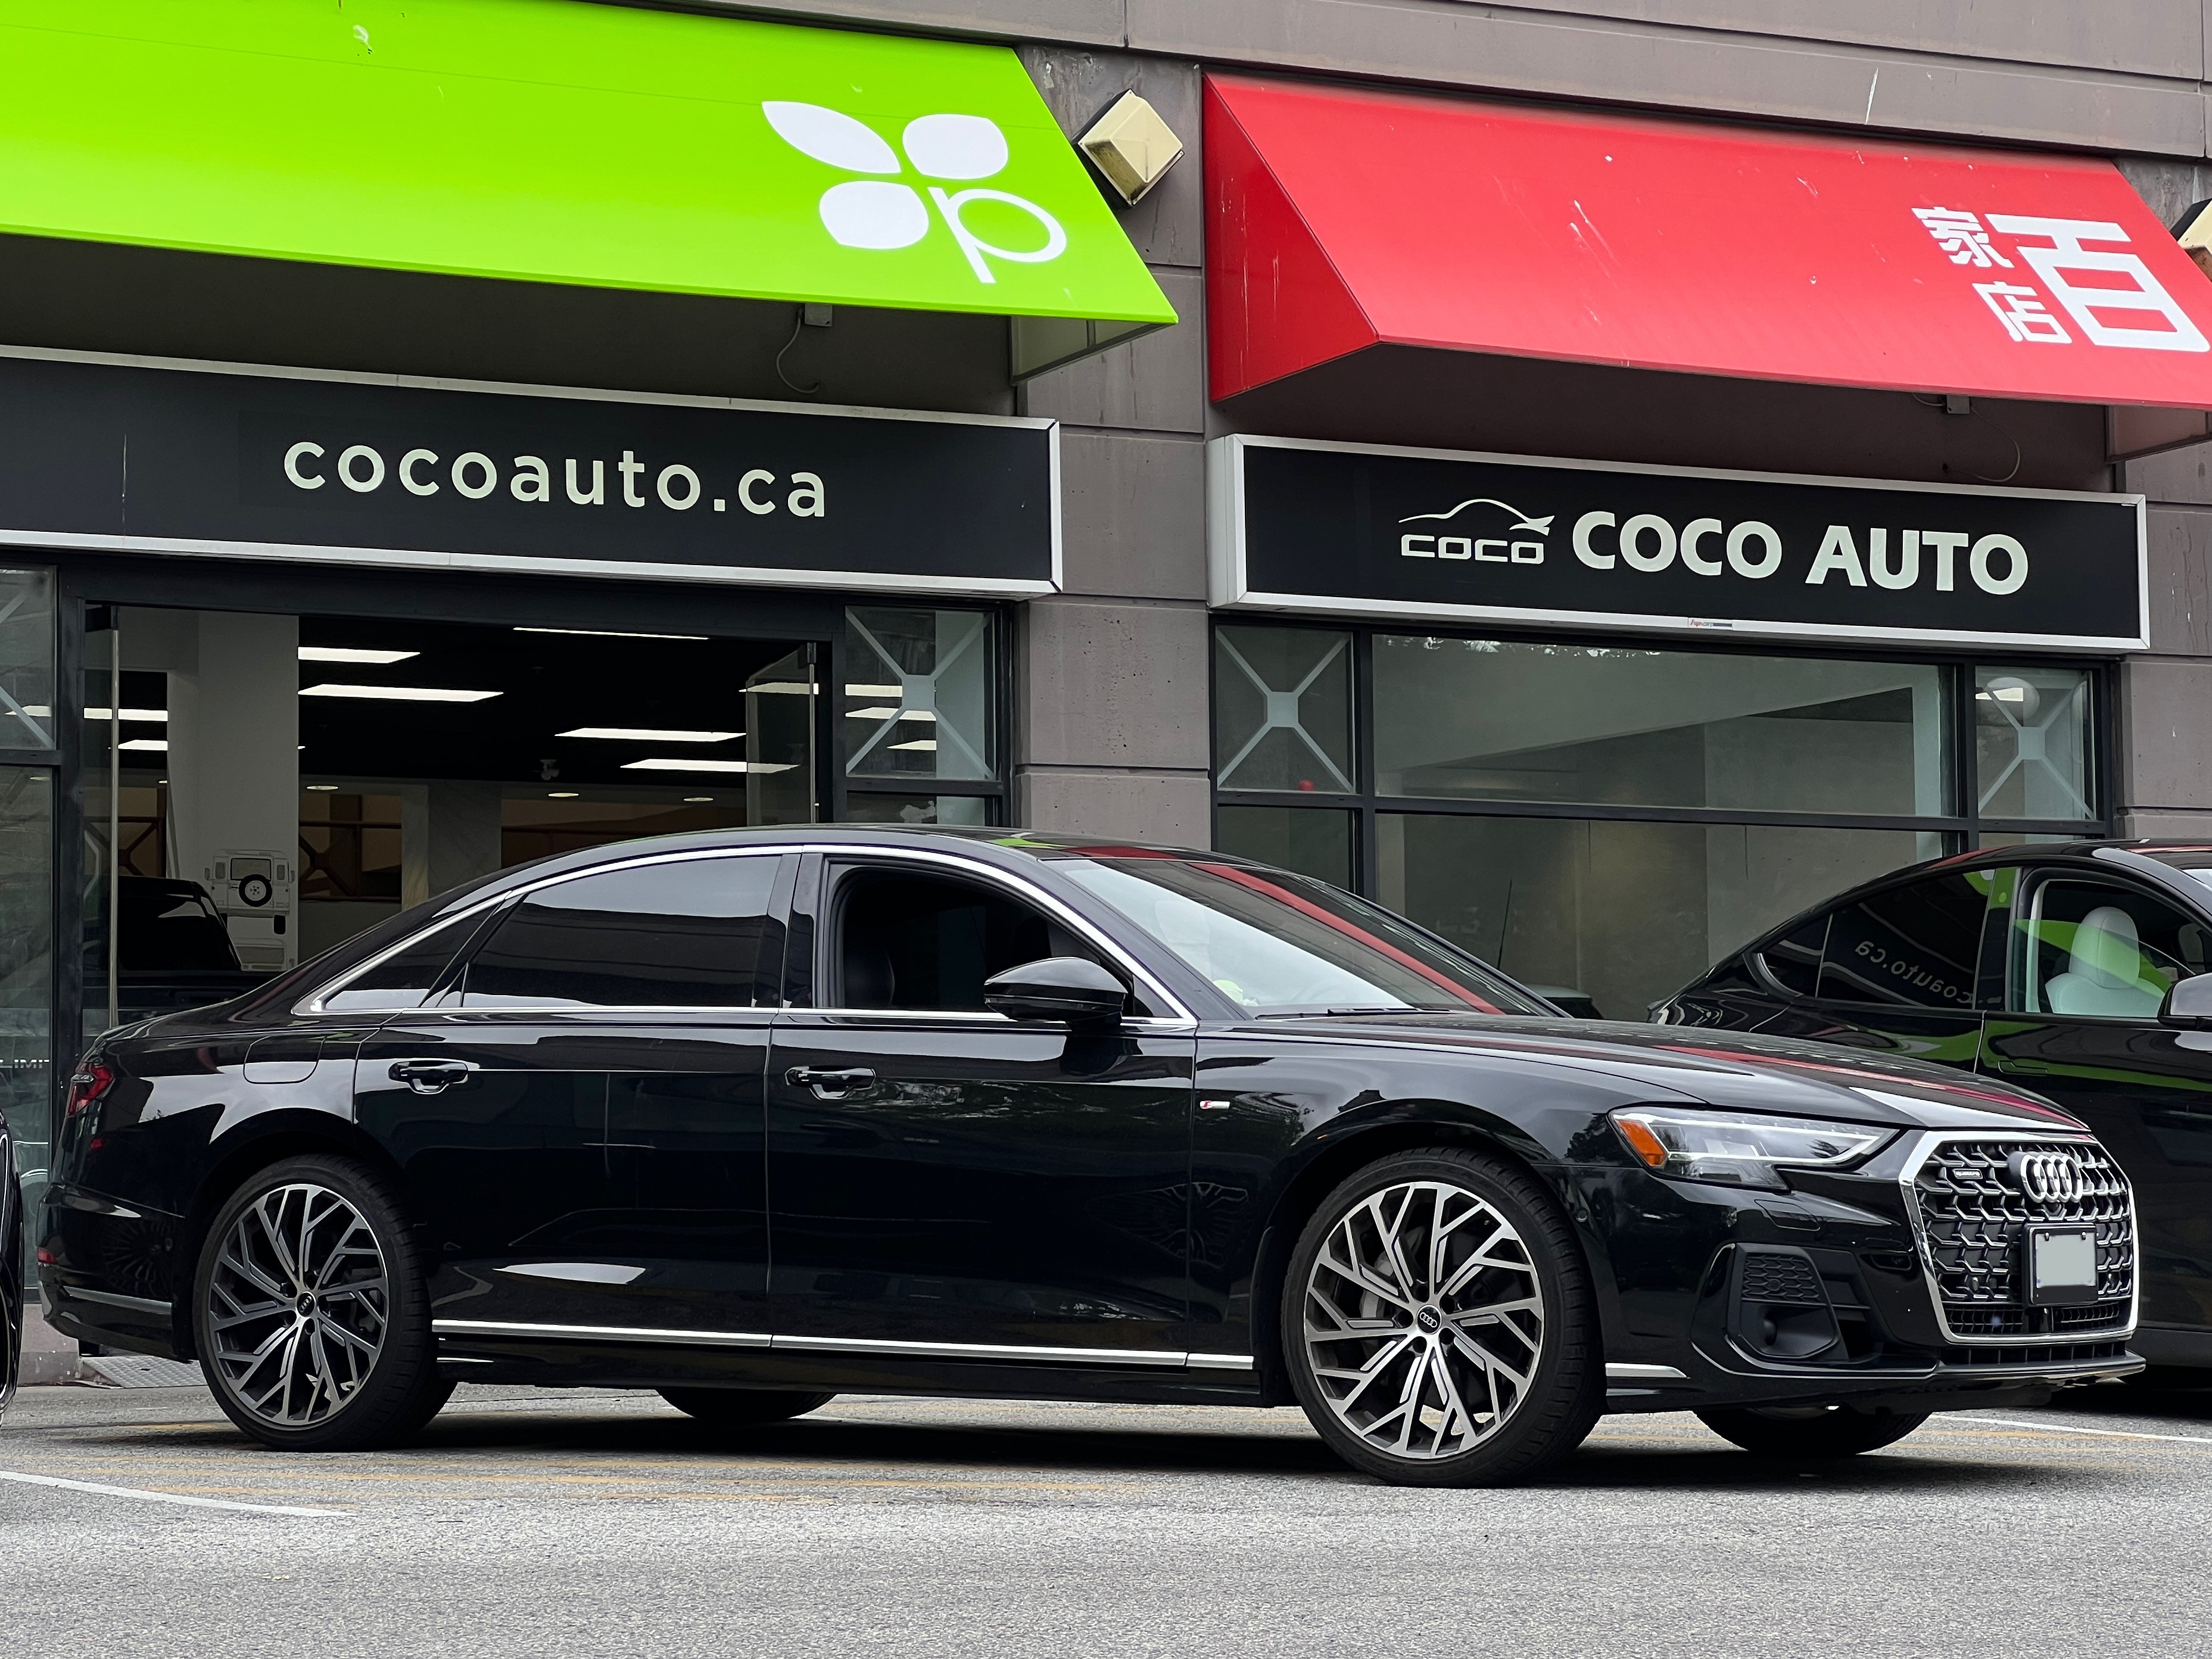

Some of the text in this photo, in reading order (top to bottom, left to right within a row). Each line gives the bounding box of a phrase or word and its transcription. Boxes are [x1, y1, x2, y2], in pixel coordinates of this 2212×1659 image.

[1984, 213, 2211, 354] 百
[283, 441, 825, 518] cocoauto.ca
[1401, 534, 1545, 565] COCO
[1572, 511, 2029, 596] COCO AUTO
